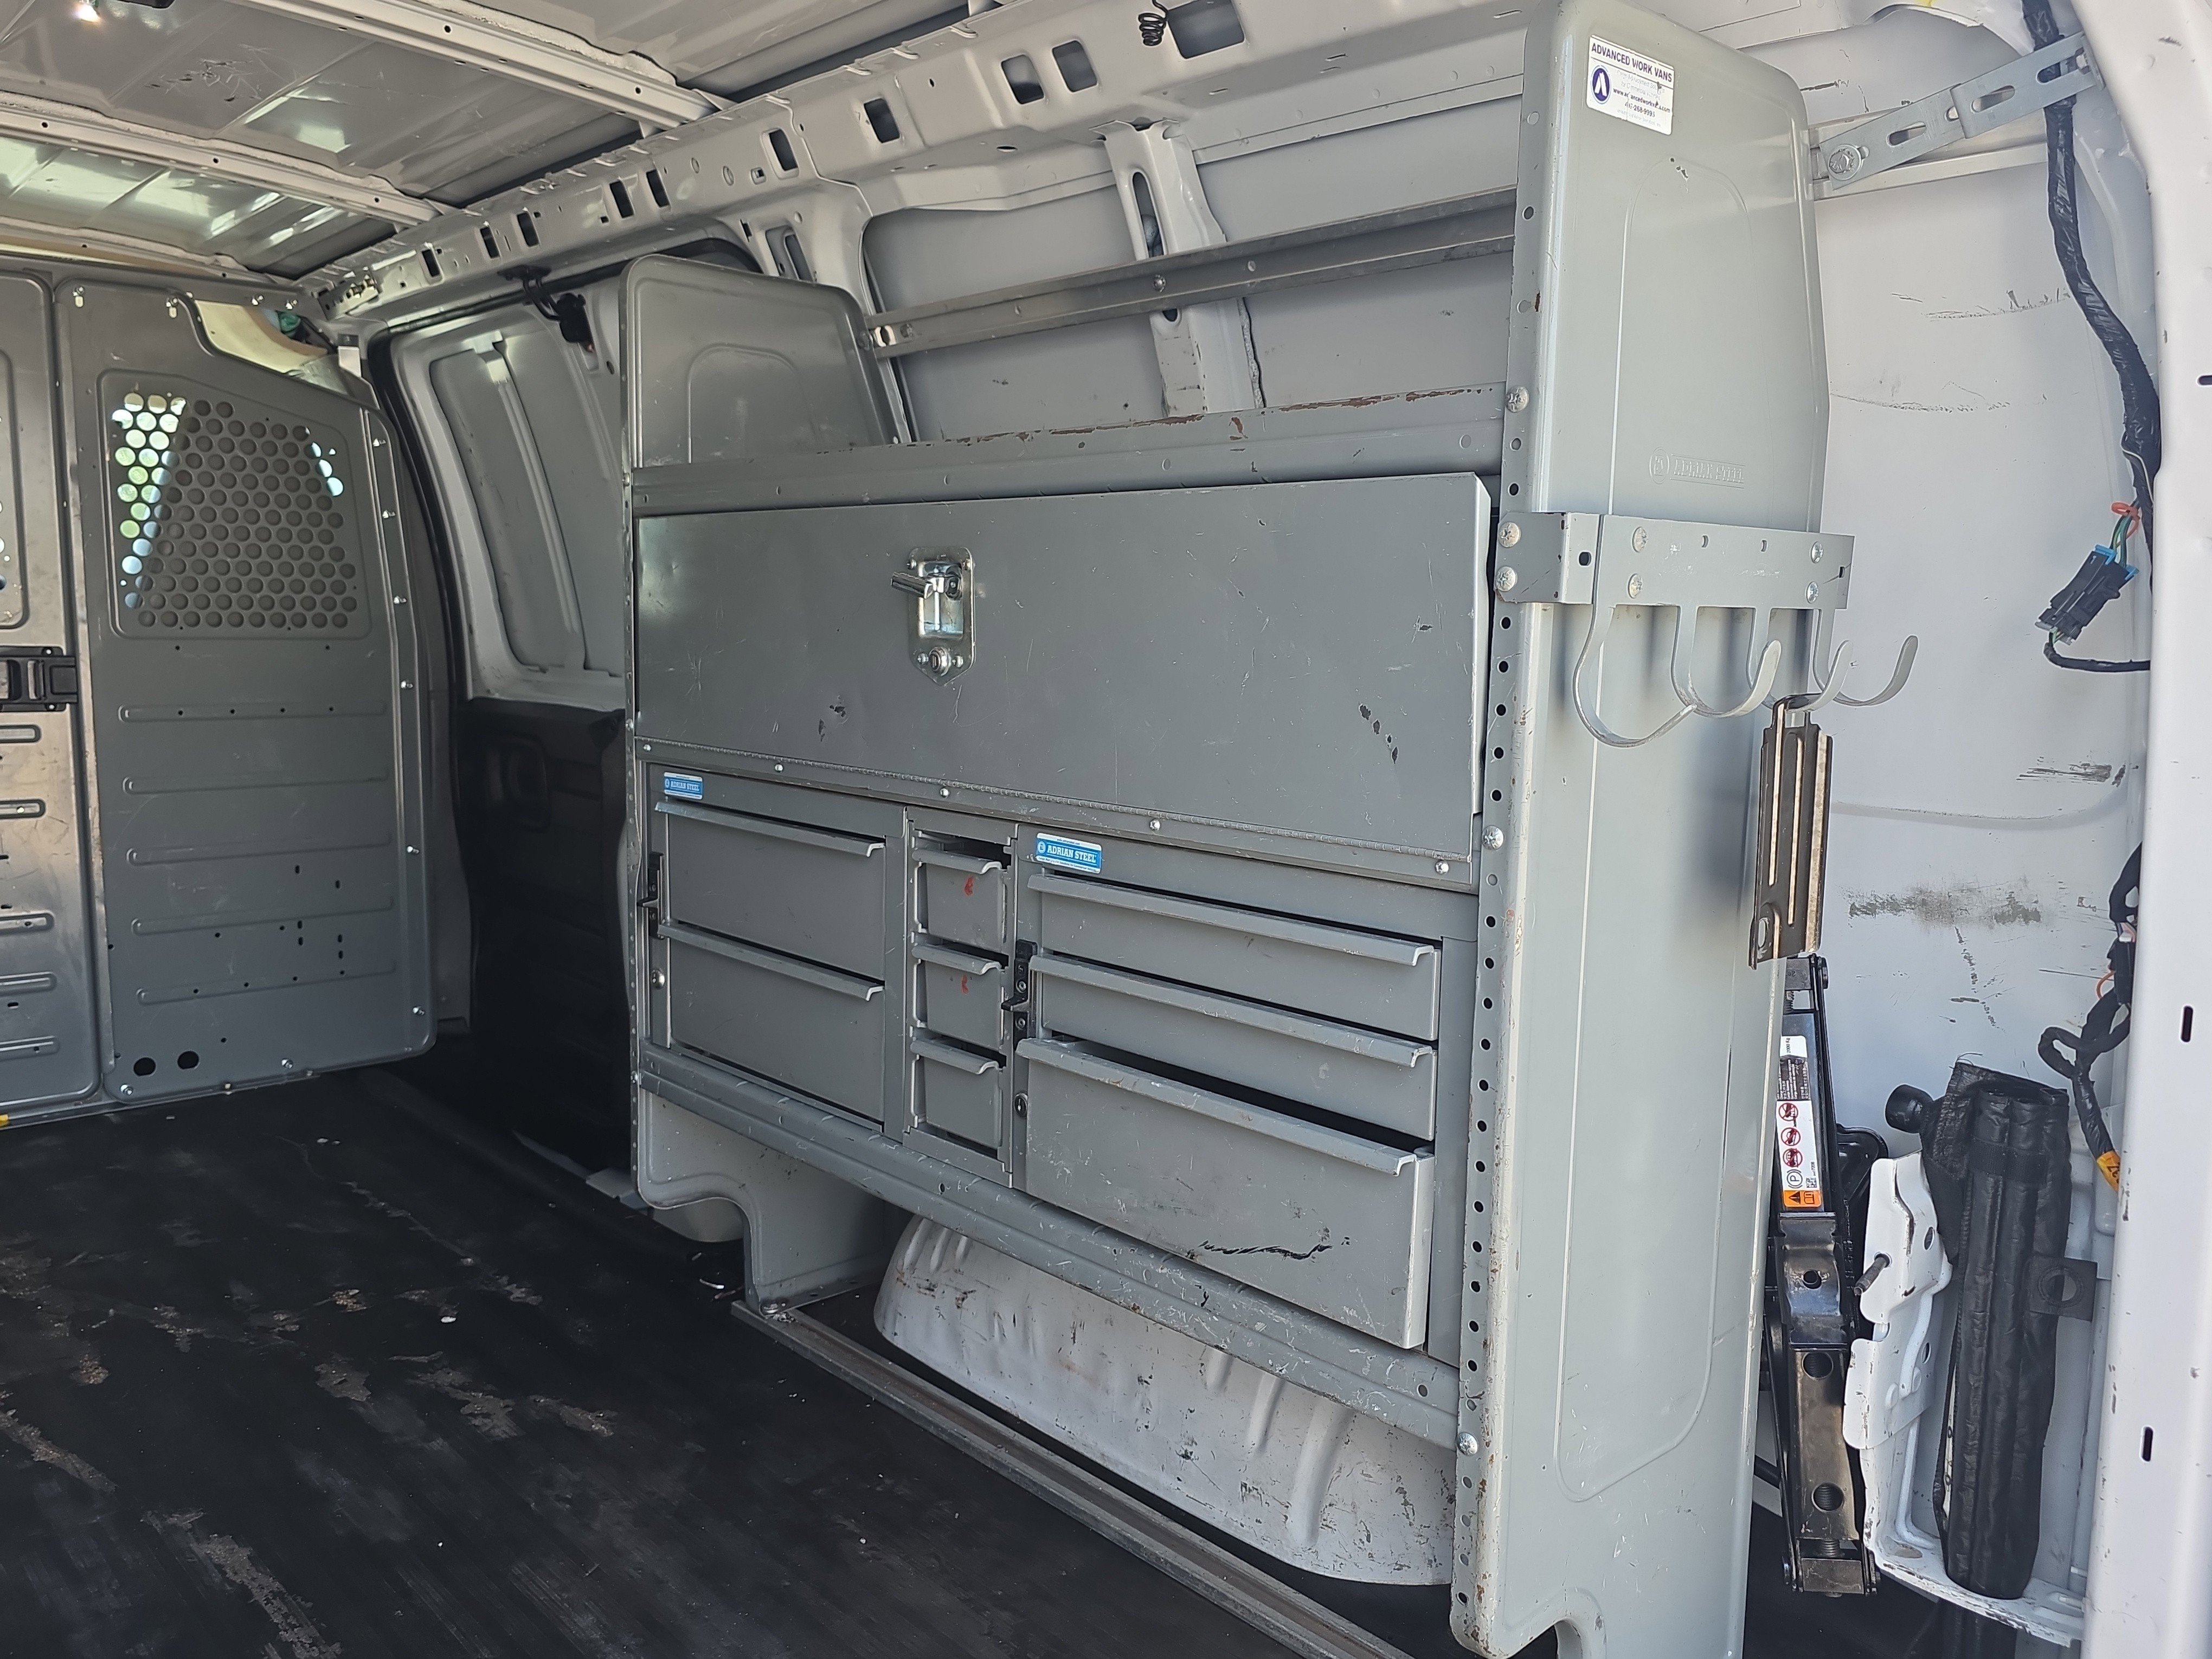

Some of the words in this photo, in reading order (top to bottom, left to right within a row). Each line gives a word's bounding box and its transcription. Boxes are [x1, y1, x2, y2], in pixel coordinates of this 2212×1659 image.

[1592, 42, 1630, 66] ADVANCED
[1632, 57, 1652, 74] WORK
[1655, 67, 1672, 82] VANS
[1047, 845, 1073, 858] ADRIAN
[1075, 850, 1096, 863] STEEL
